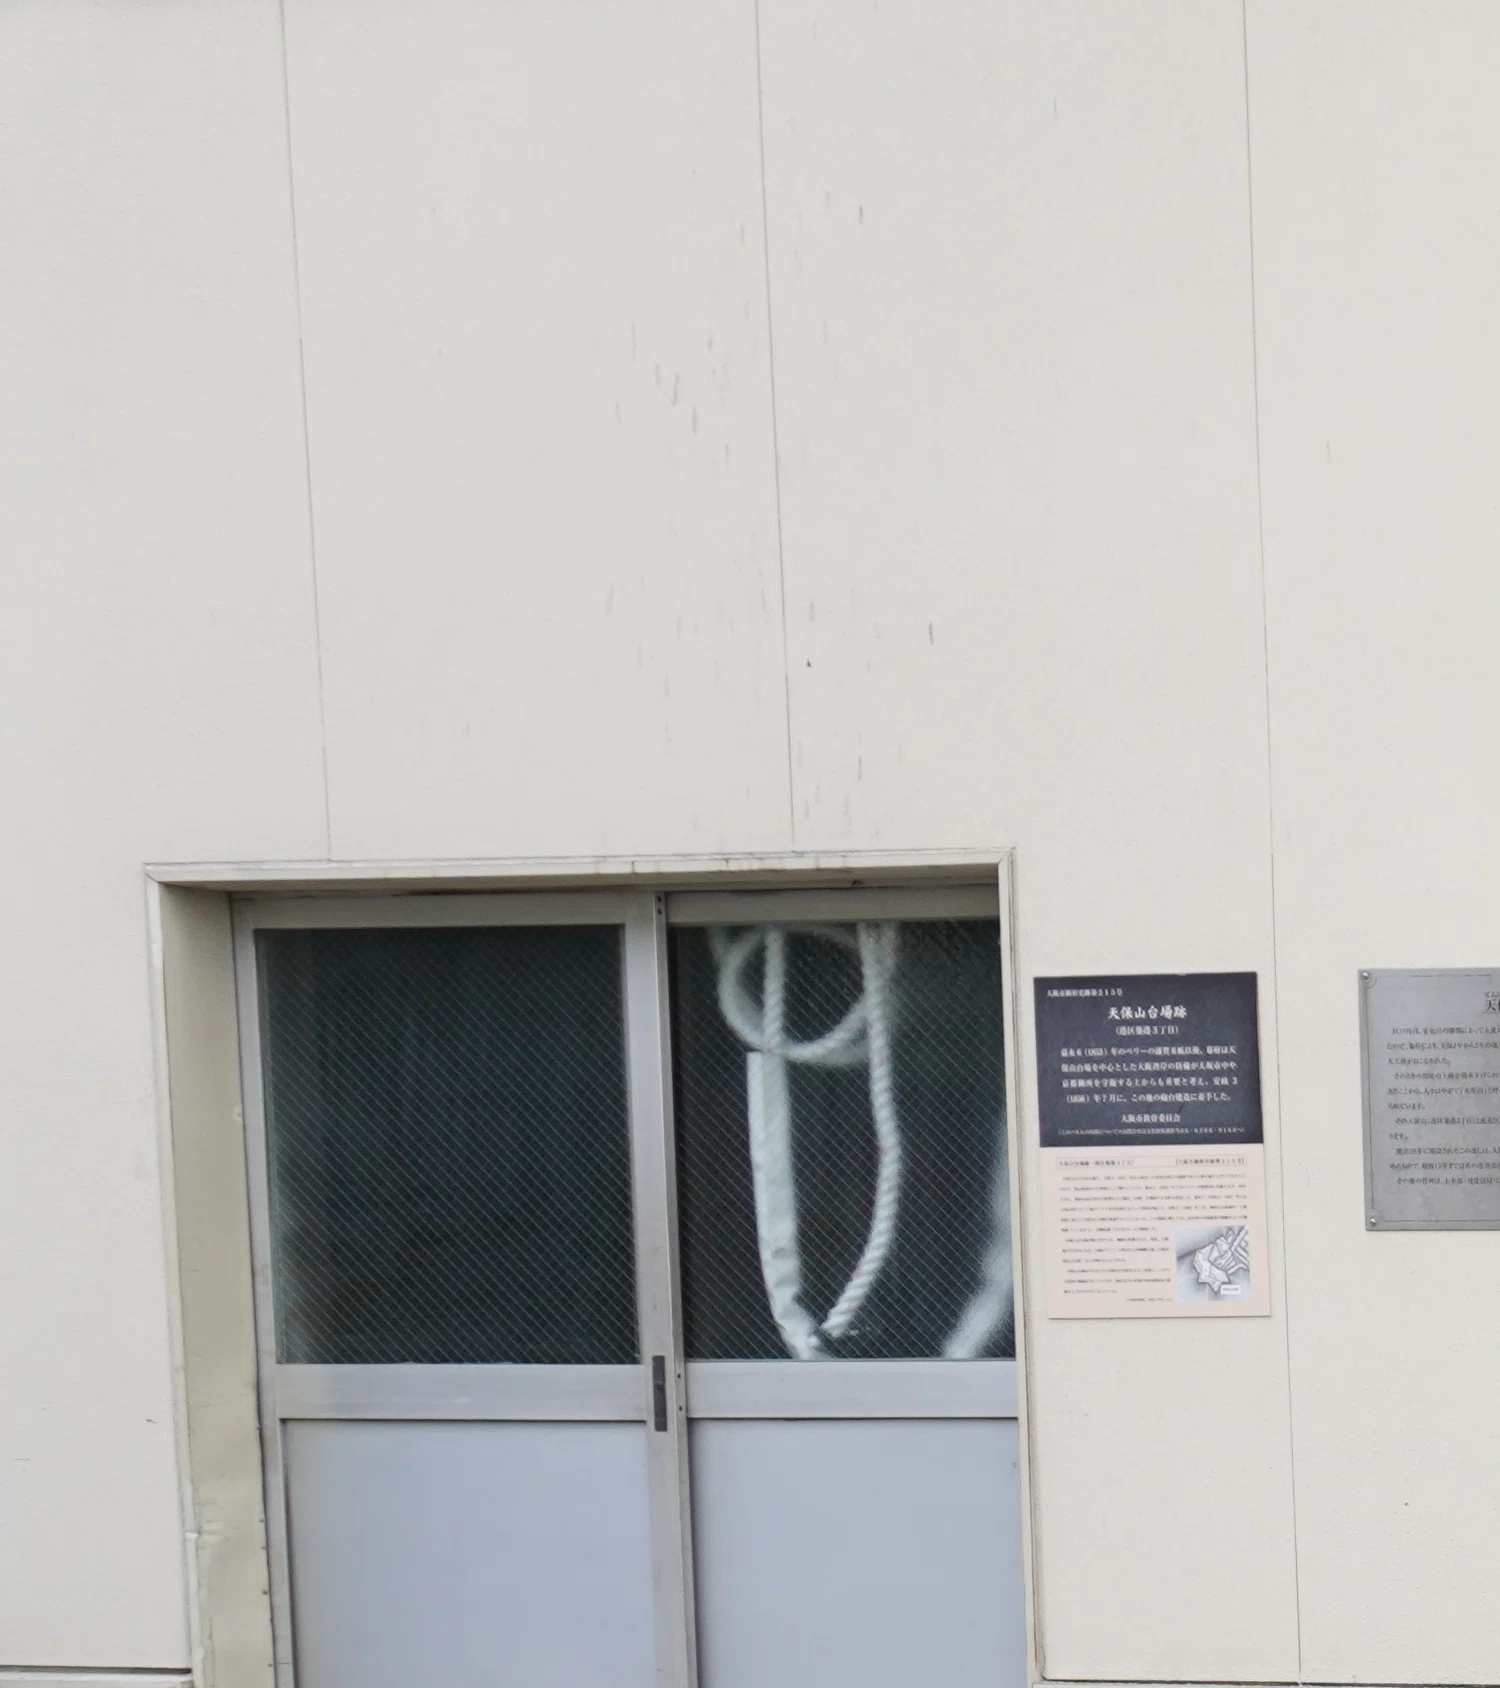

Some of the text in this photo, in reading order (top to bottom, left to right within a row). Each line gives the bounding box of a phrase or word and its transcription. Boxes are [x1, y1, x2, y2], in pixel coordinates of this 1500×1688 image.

[1107, 1004, 1188, 1020] 天保山台場跡
